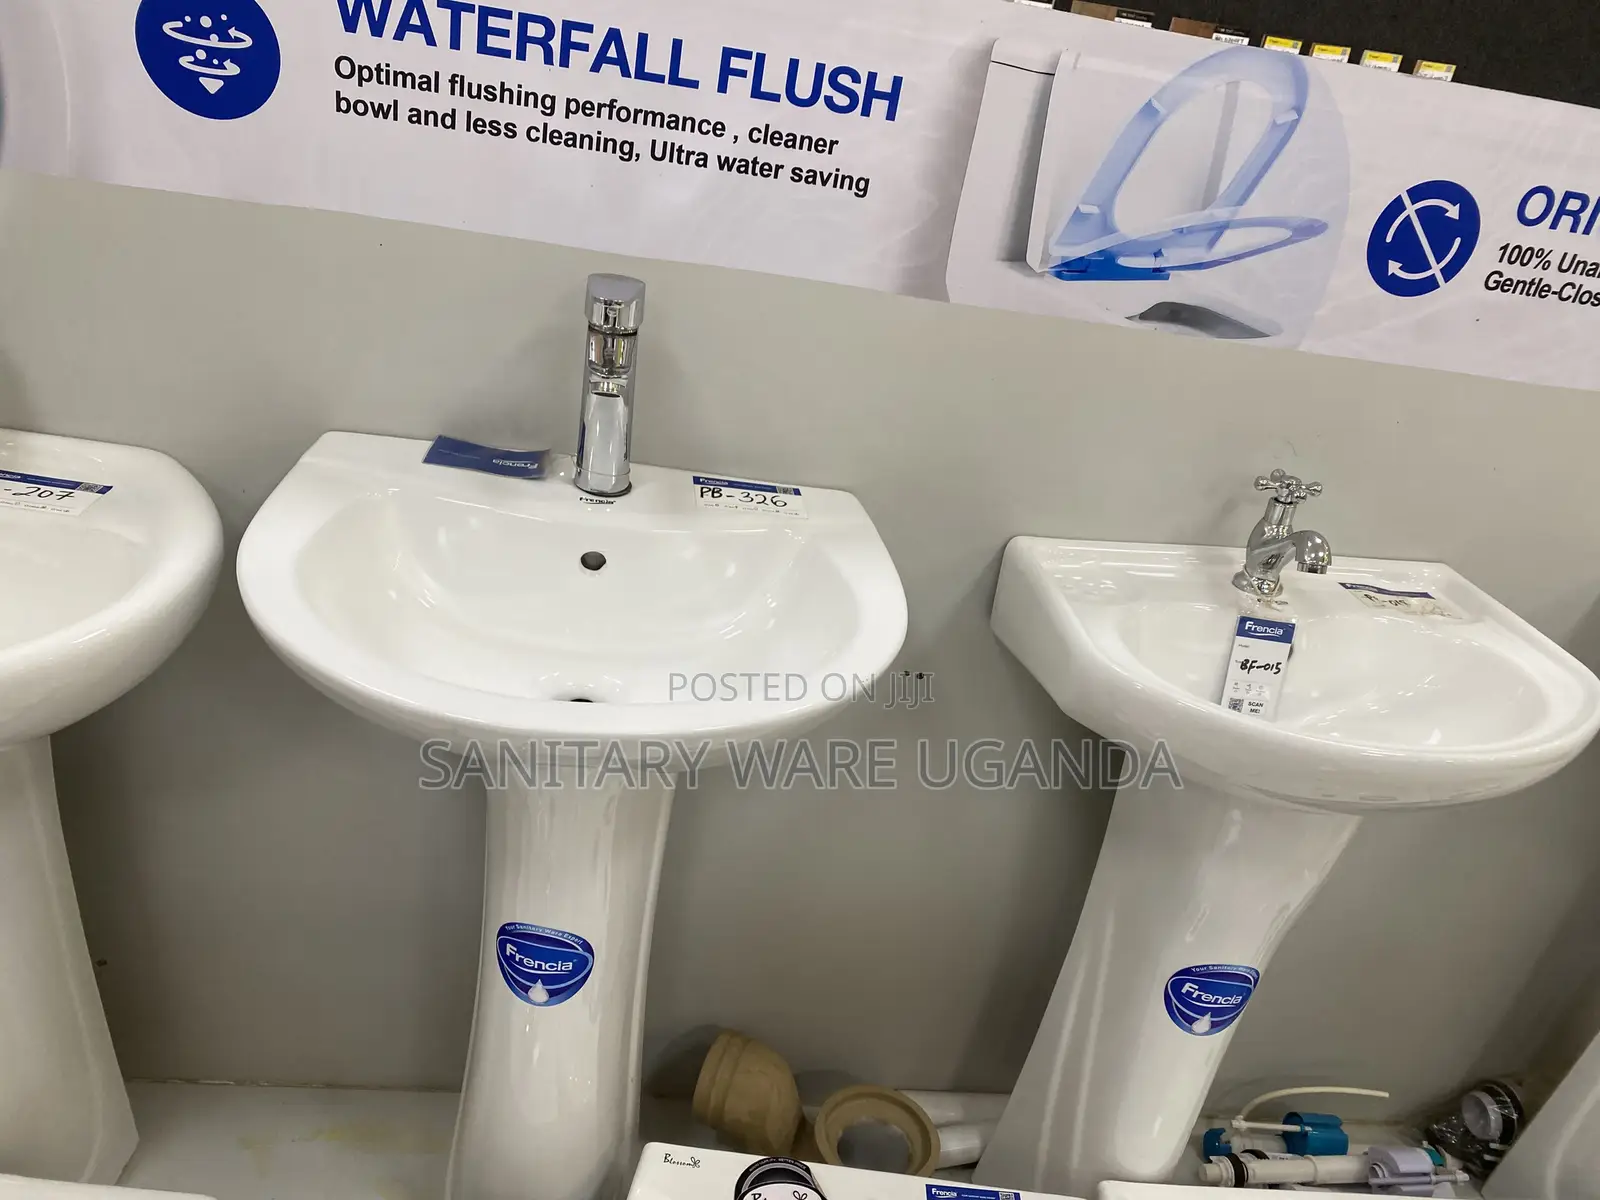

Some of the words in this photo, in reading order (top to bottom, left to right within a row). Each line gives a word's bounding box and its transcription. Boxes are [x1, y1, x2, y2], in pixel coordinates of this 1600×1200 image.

[335, 0, 700, 89] WATERFALL
[717, 46, 904, 122] FLUSH
[334, 55, 440, 93] Optimal
[448, 73, 557, 117] flushing
[564, 96, 726, 138] performance
[748, 123, 839, 155] cleaner
[335, 90, 399, 122] bowl
[407, 106, 457, 131] and
[465, 110, 518, 140] less
[526, 122, 641, 163] cleaning,
[650, 139, 709, 168] Ultra
[716, 154, 784, 180] water
[789, 166, 871, 199] saving
[1498, 242, 1554, 271] 100%
[1557, 251, 1600, 279] Una
[700, 486, 788, 508] PB-326
[1244, 620, 1284, 637] Frencia
[564, 932, 584, 945] Expert
[505, 943, 573, 972] Frencia
[1181, 982, 1243, 1005] Frencia
[663, 1152, 697, 1168] Blossom
[931, 1188, 958, 1198] Frencia
